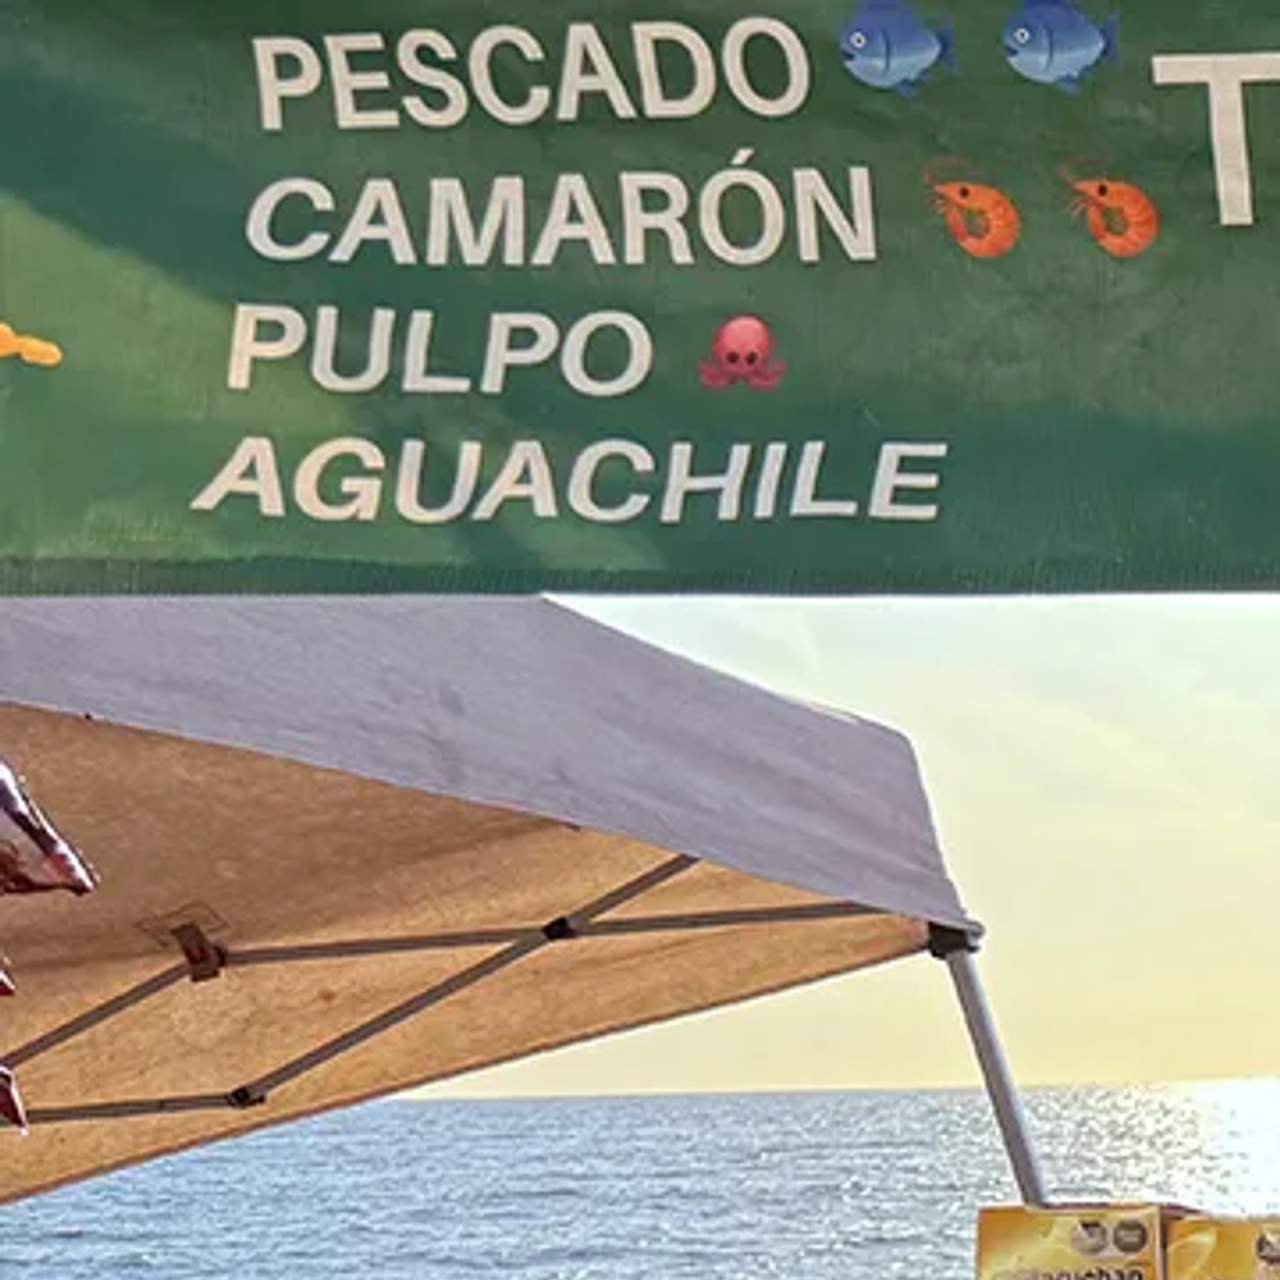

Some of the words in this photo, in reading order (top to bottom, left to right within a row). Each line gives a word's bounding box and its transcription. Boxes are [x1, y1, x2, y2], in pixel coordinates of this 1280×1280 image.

[253, 18, 809, 130] PESCADO
[246, 149, 877, 266] CAMARÓN
[227, 304, 652, 396] PULPO
[190, 437, 949, 524] AGUACHILE
